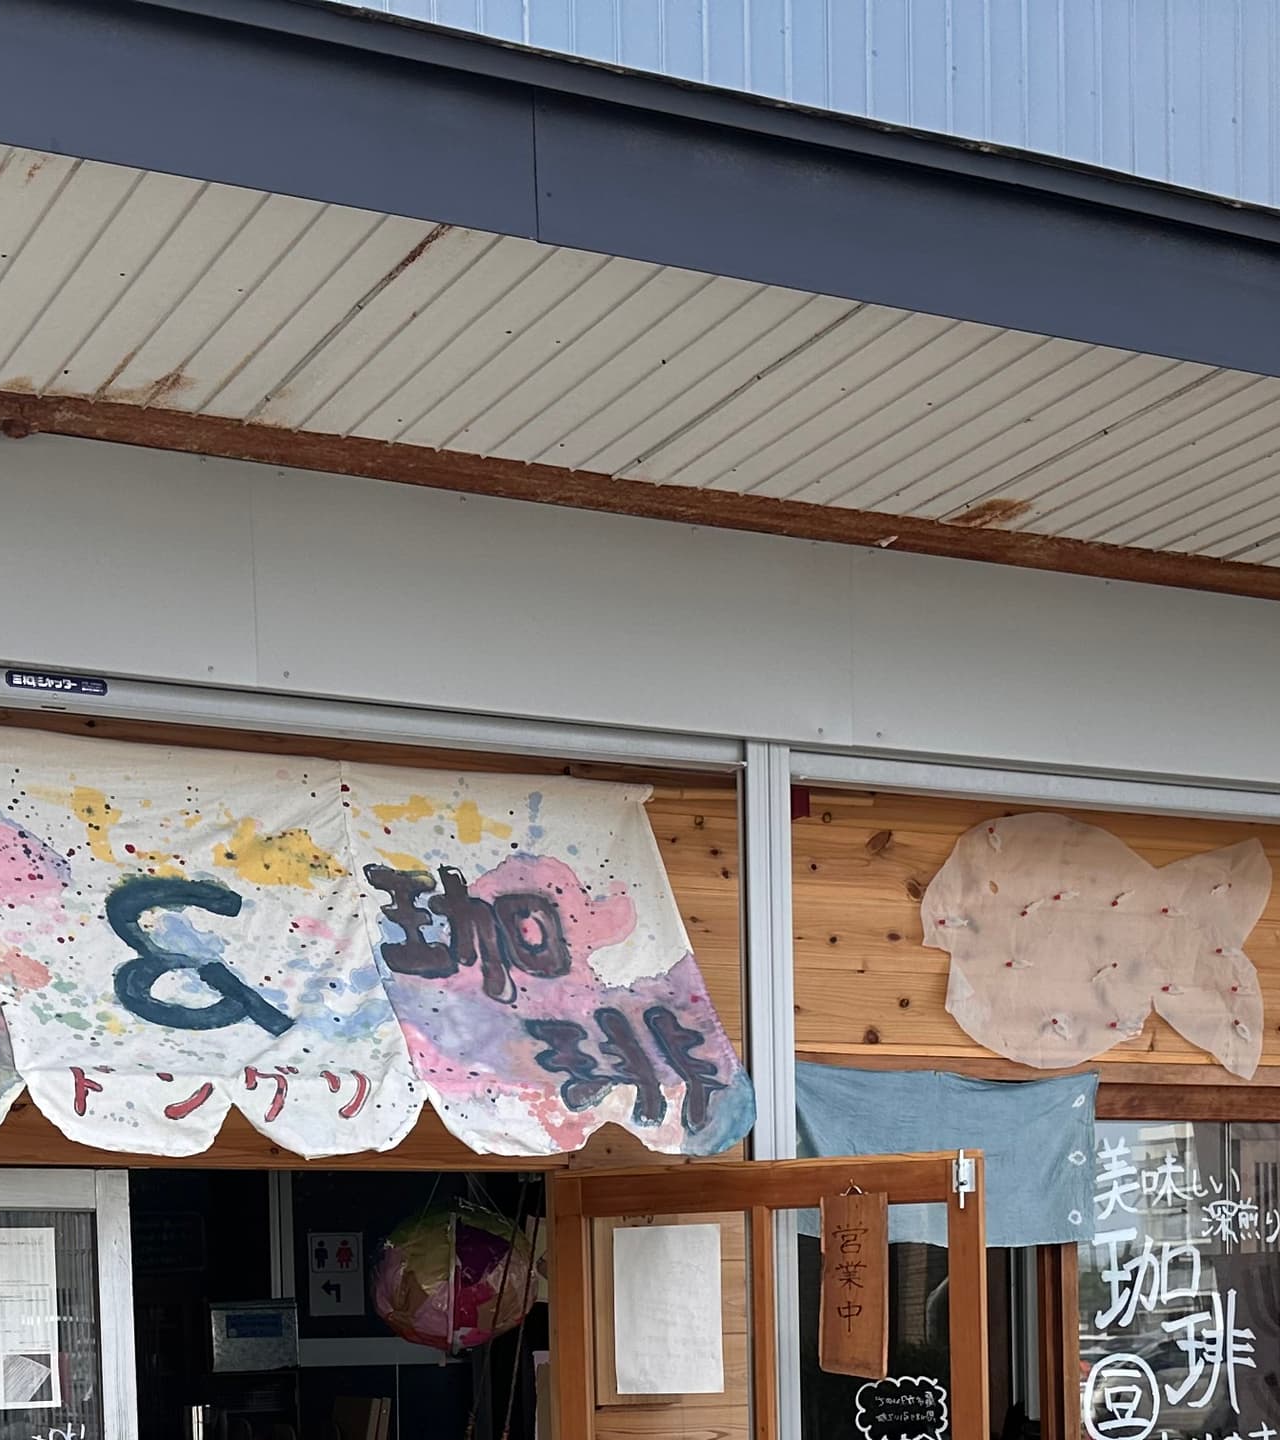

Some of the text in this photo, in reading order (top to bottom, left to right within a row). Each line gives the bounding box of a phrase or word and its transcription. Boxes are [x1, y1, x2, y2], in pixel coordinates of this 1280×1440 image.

[106, 875, 294, 1035] &
[365, 863, 725, 1132] 珈琲
[69, 1065, 372, 1121] ドングリ
[1093, 1136, 1240, 1220] 美味しい
[832, 1222, 868, 1333] 営業中
[1092, 1228, 1257, 1414] 珈琲
[1092, 1361, 1155, 1438] 豆
